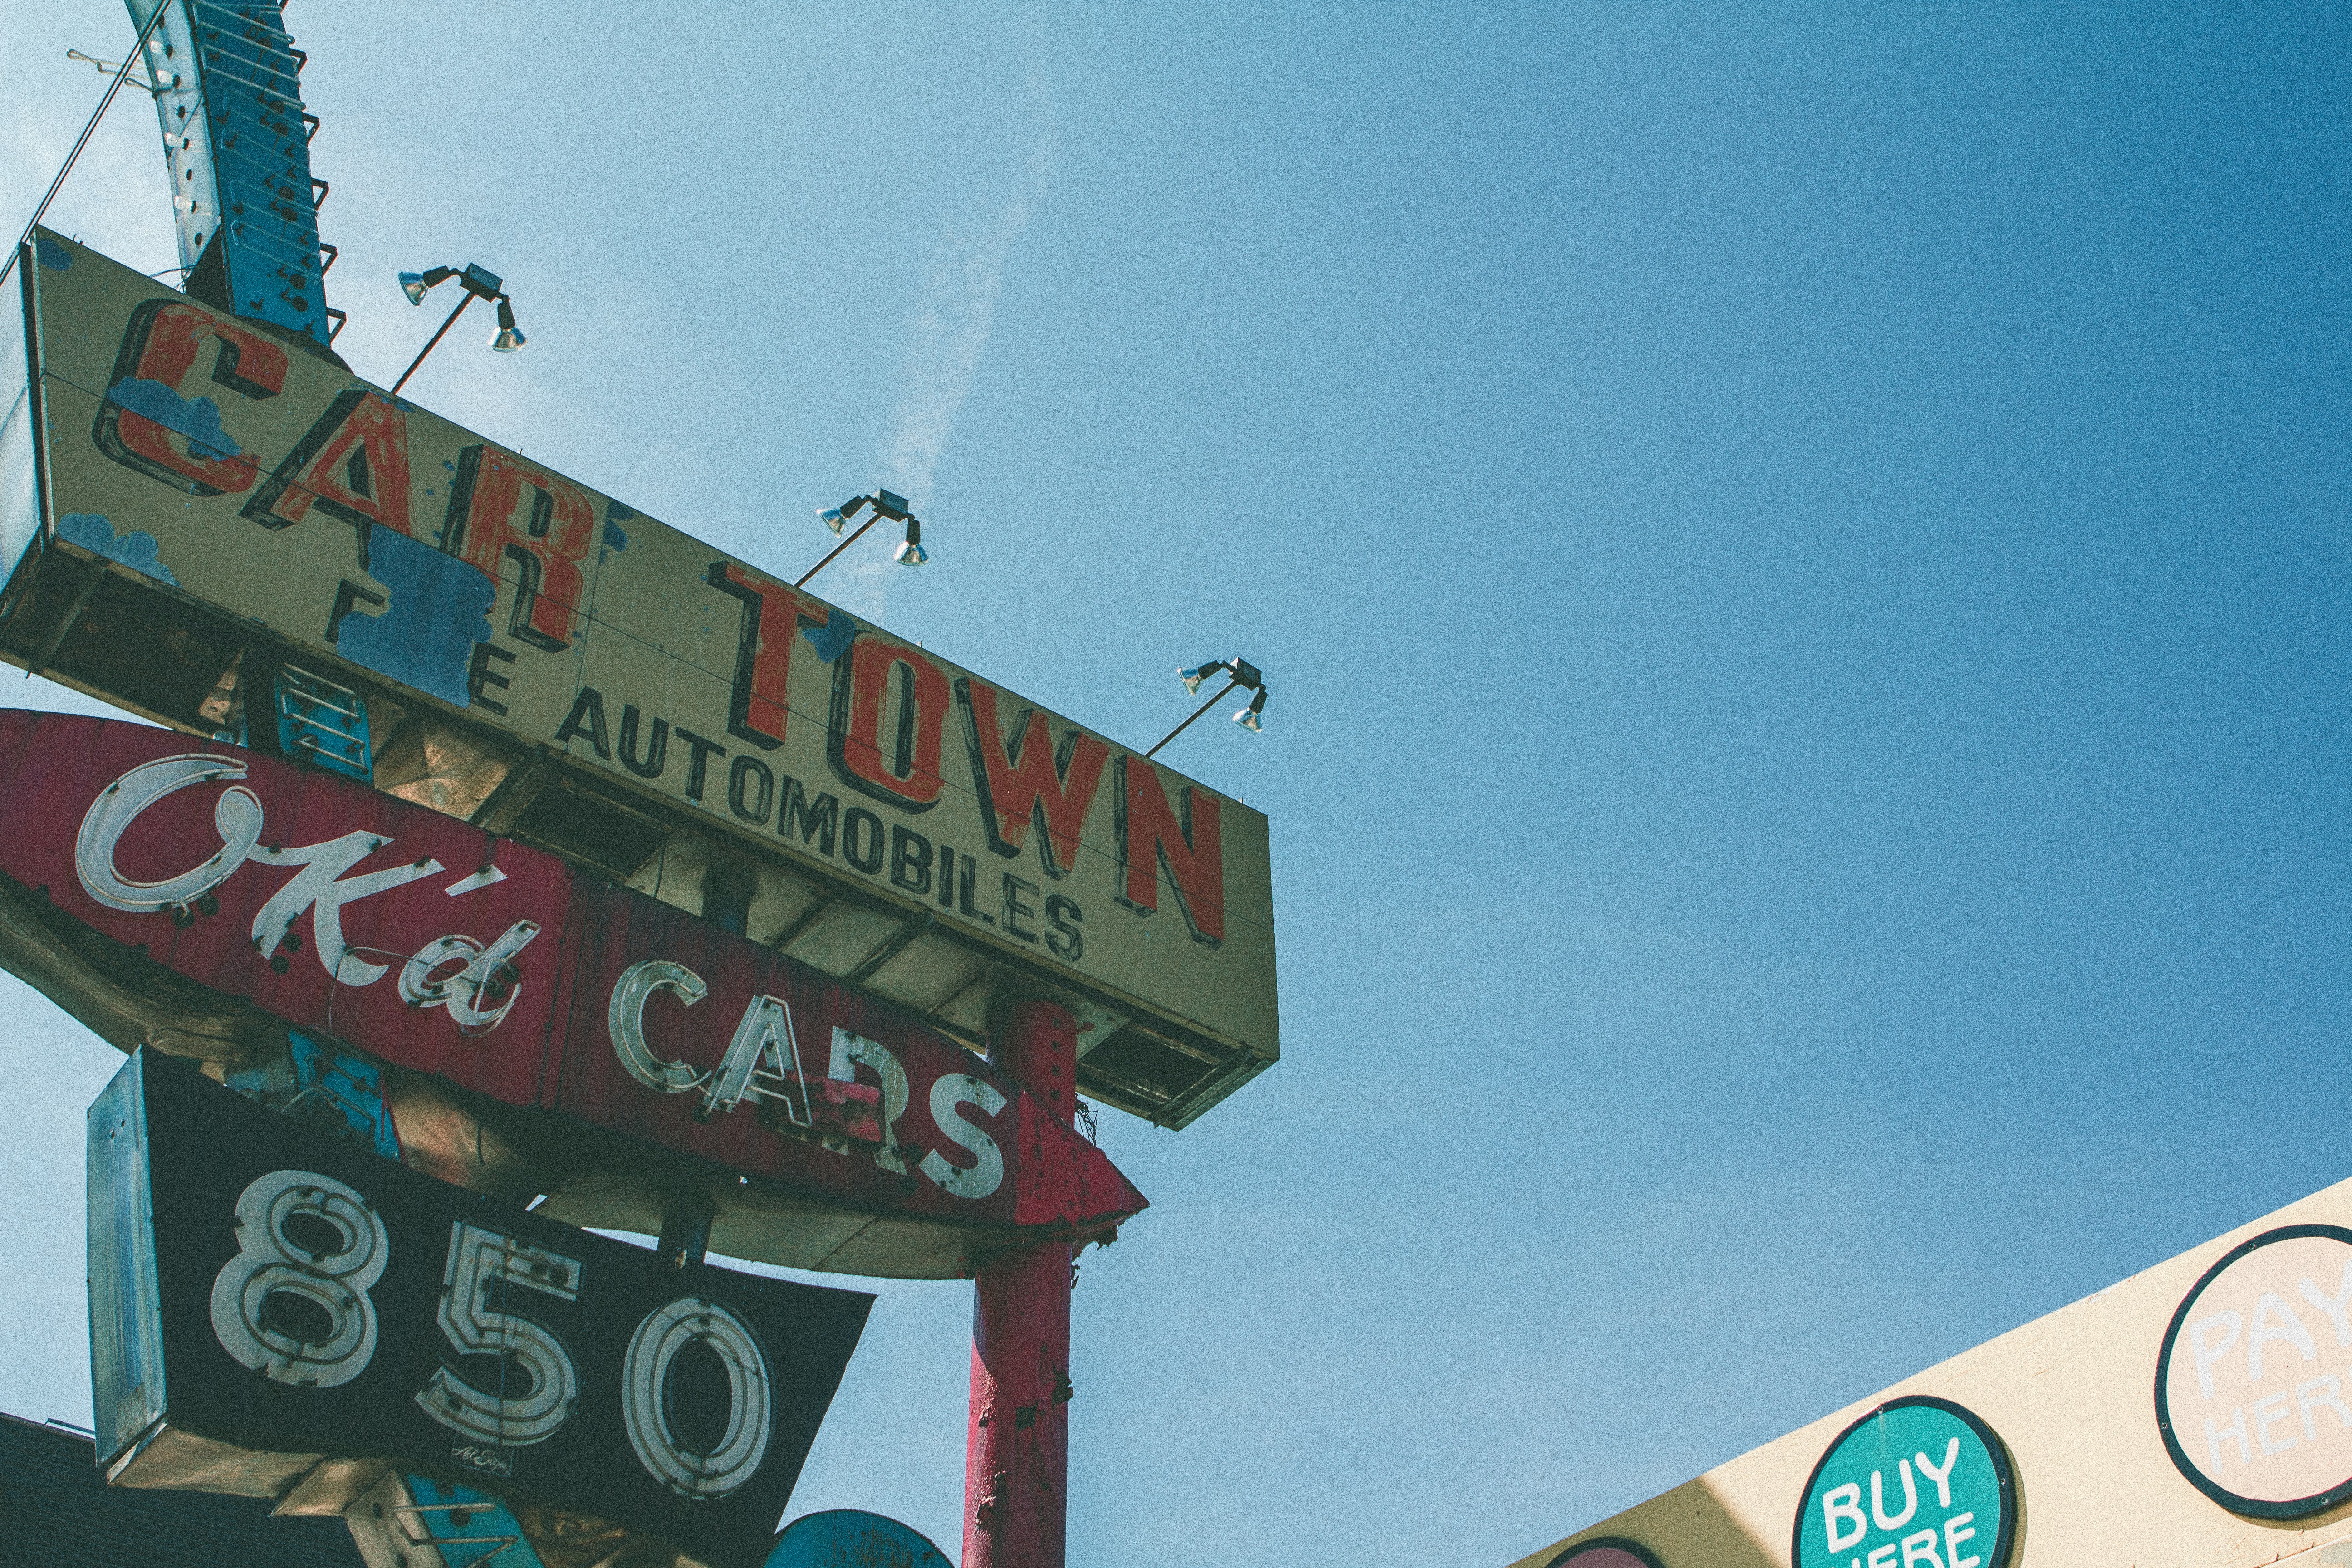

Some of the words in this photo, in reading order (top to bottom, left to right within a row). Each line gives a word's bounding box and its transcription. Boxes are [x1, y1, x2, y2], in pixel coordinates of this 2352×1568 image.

[92, 298, 594, 654] CAR
[708, 561, 1225, 950] TOWN
[324, 579, 516, 717] FE
[555, 686, 1083, 962] AUTOMOBILES
[608, 960, 1007, 1199] CARS
[210, 1170, 777, 1501] 850
[2190, 1258, 2352, 1399] PAY
[2205, 1366, 2352, 1474] HER
[1823, 1437, 1960, 1554] BUY
[1830, 1511, 1980, 1568] RE
